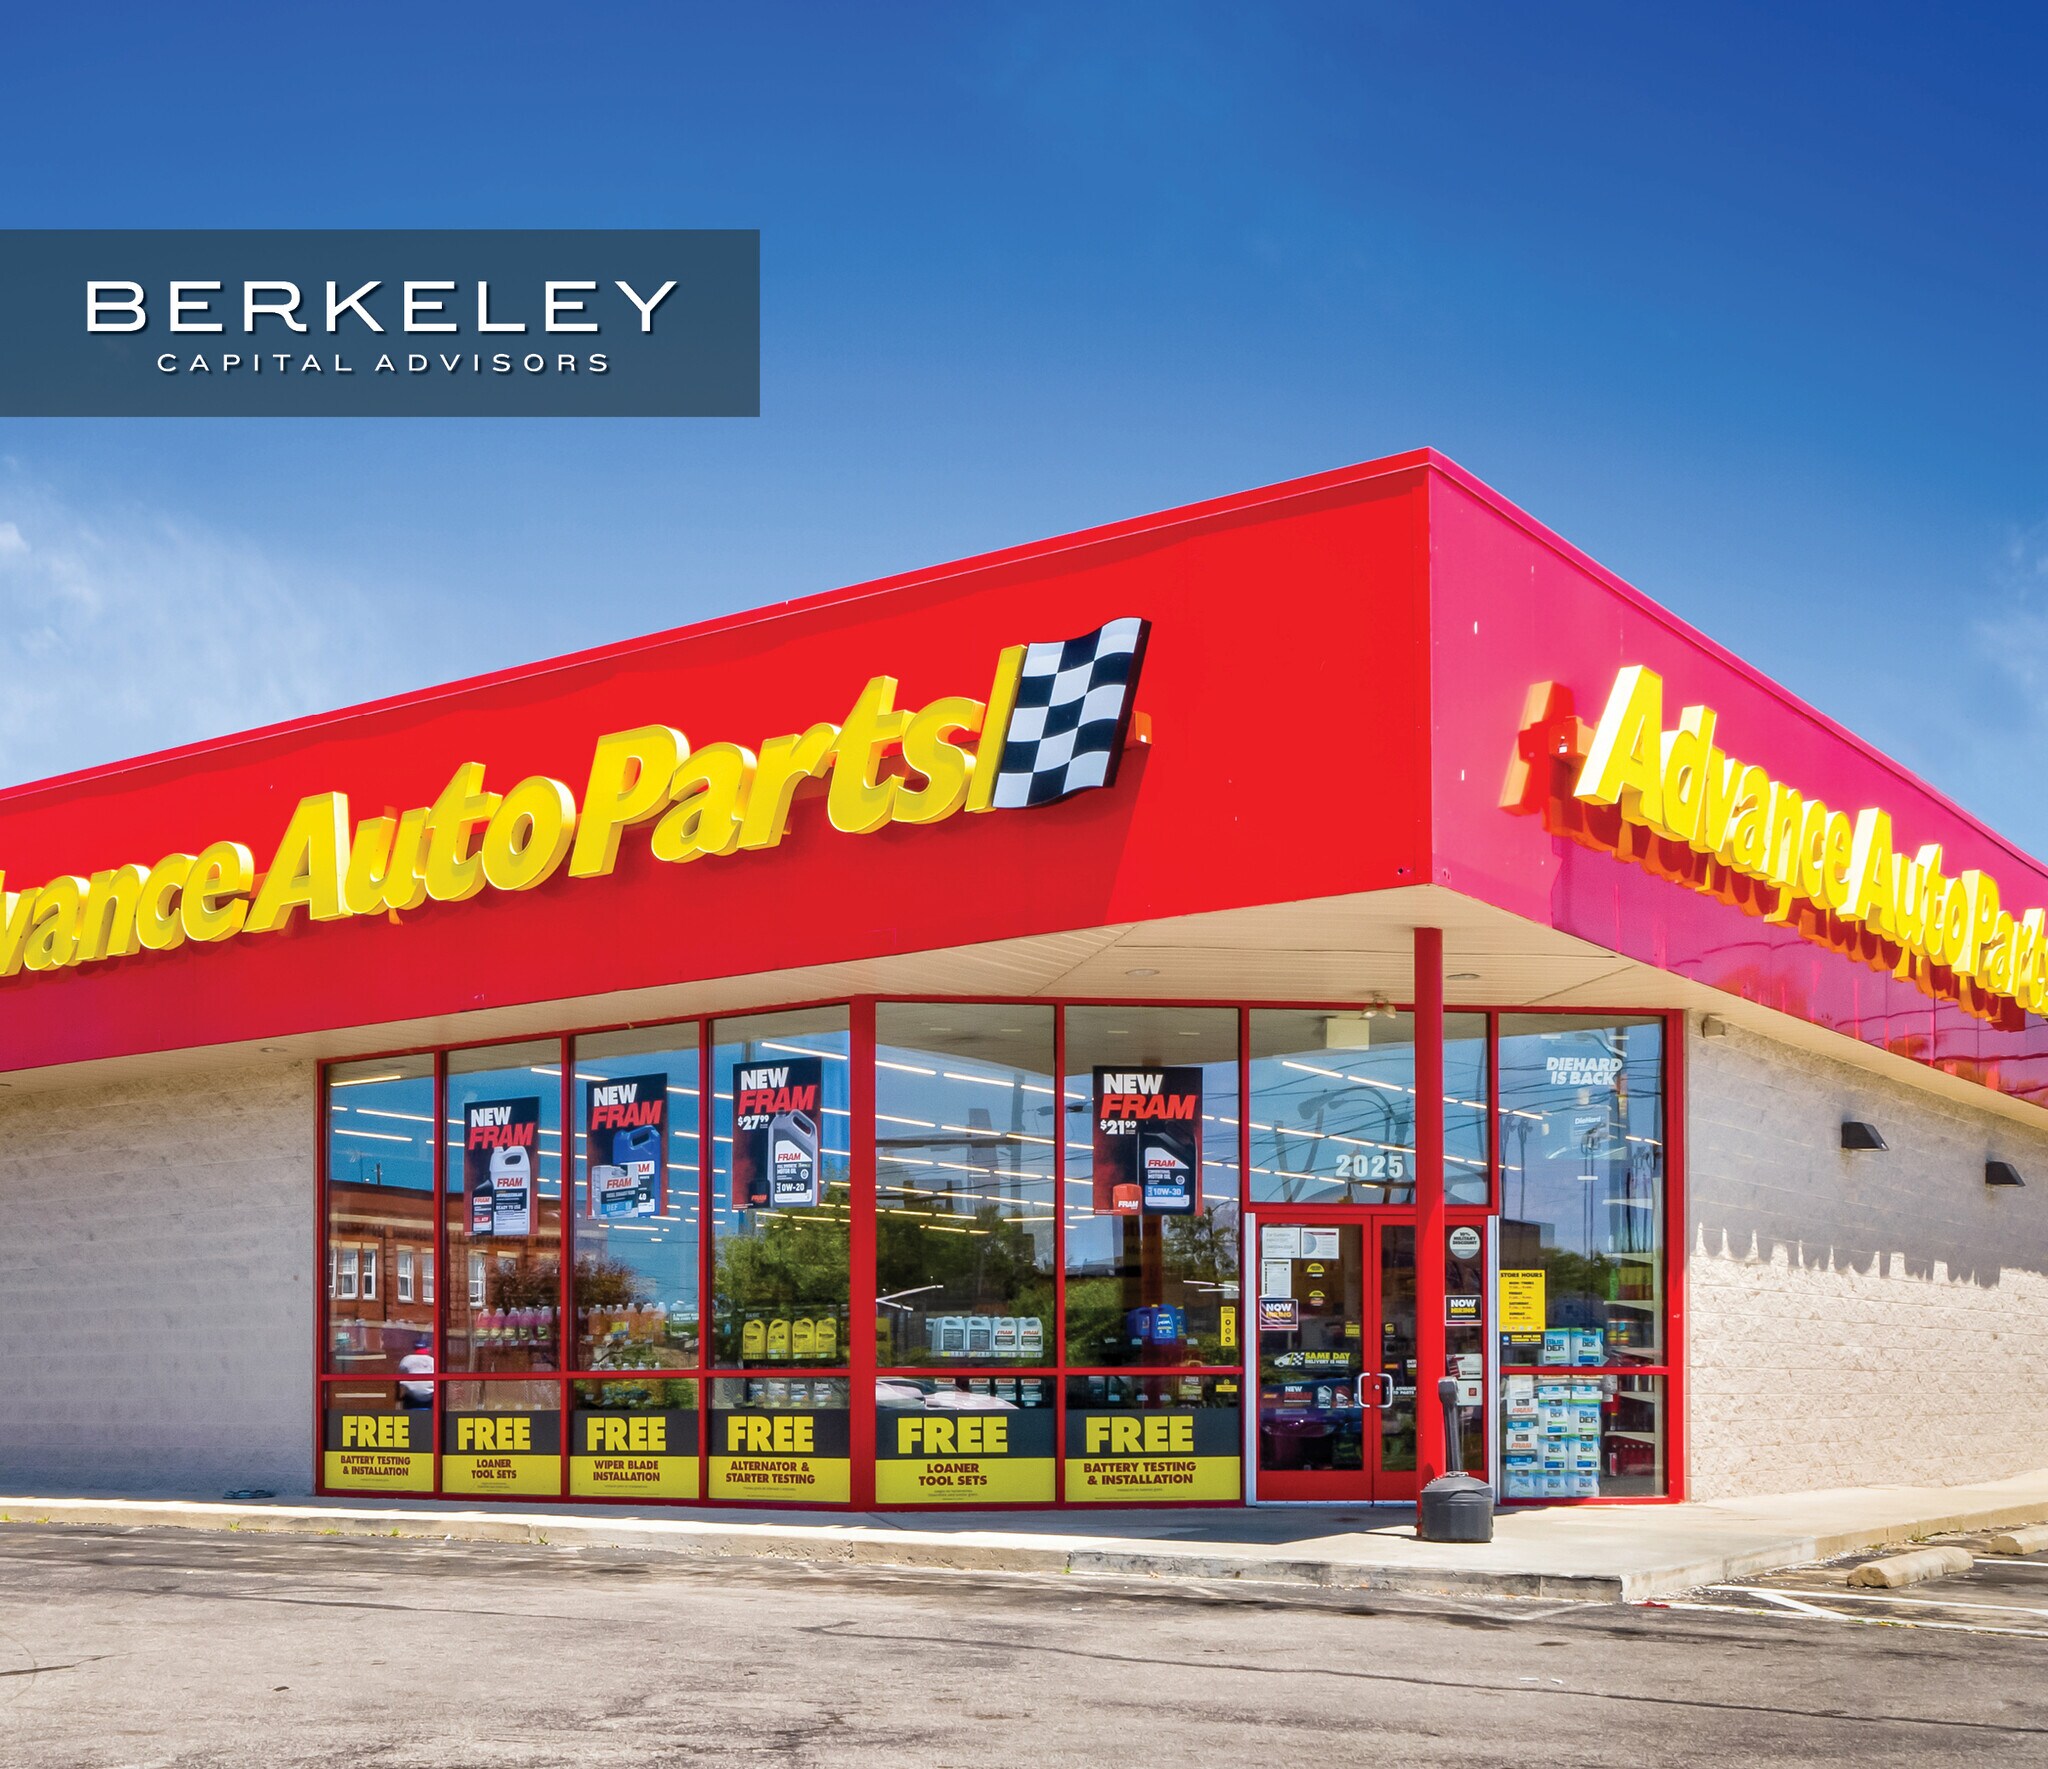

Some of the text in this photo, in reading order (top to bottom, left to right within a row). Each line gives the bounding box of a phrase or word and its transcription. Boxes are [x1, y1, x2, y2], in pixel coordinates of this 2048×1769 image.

[1546, 1056, 1623, 1072] DIEHARD
[740, 1066, 789, 1091] NEW
[1103, 1073, 1164, 1095] NEW
[1551, 1072, 1617, 1086] IS BACK
[593, 1083, 638, 1107] NEW
[738, 1084, 818, 1116] FRAM
[1100, 1094, 1198, 1120] FRAM
[470, 1105, 512, 1128] NEW
[591, 1099, 664, 1131] FRAM
[468, 1122, 536, 1151] FRAM
[777, 1152, 801, 1162] FRAM
[1148, 1159, 1176, 1167] FRAM
[1335, 1154, 1404, 1178] 2025
[496, 1177, 523, 1188] FRAM
[606, 1177, 632, 1190] FRAM
[781, 1182, 805, 1192] 0W-20
[1153, 1187, 1182, 1196] 10W-30
[1265, 1303, 1292, 1312] NOW
[1450, 1299, 1476, 1307] NOW
[1304, 1352, 1351, 1360] SAME DAY
[342, 1415, 410, 1448] FREE
[457, 1417, 531, 1451] FREE
[586, 1416, 666, 1452] FREE
[727, 1415, 814, 1453] FREE
[897, 1416, 1008, 1455] FREE
[1086, 1415, 1194, 1454] FREE
[340, 1455, 411, 1466] BATTERY TESTING
[476, 1459, 511, 1469] LOANER
[594, 1460, 659, 1471] WIPER BLADE
[730, 1461, 810, 1472] ALTERNATOR &
[342, 1466, 409, 1476] & INSTALLATION
[471, 1469, 517, 1479] TOOL SETS
[926, 1463, 980, 1474] LOANER
[1083, 1461, 1197, 1474] BATTERY TESTING
[592, 1471, 661, 1482] INSTALLATION
[726, 1472, 816, 1485] STARTER TESTING
[918, 1475, 988, 1487] TOOL SETS
[1087, 1473, 1193, 1486] & INSTALLATION
